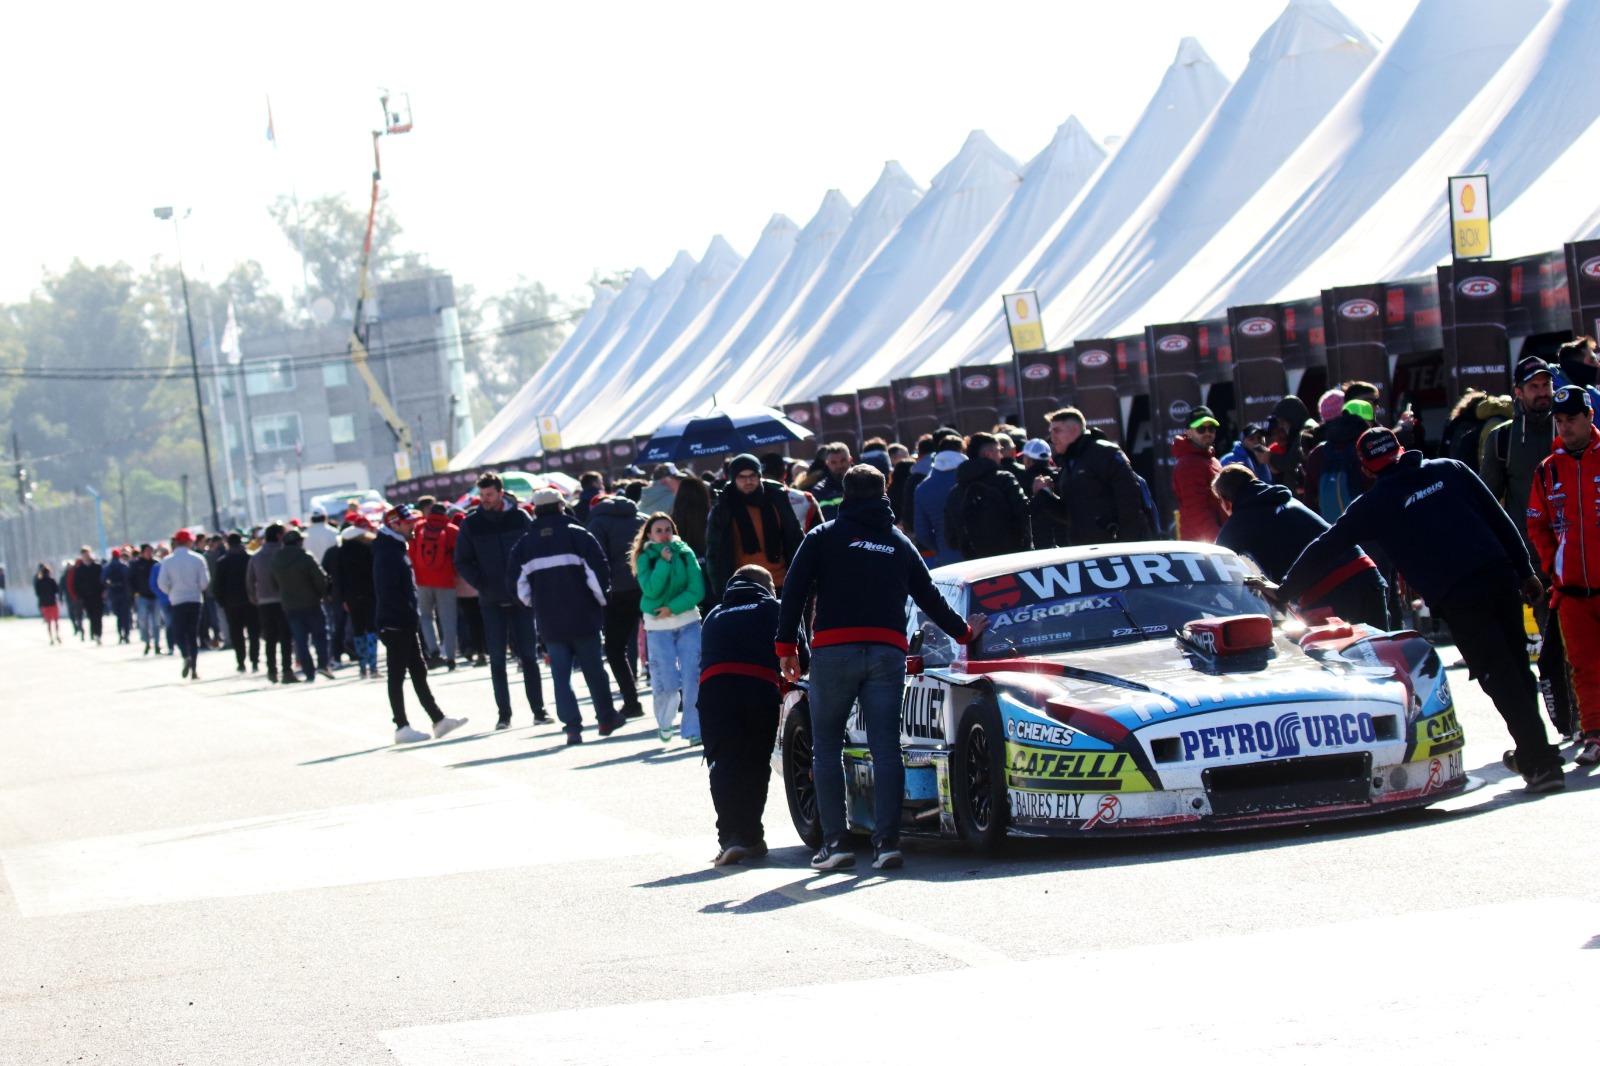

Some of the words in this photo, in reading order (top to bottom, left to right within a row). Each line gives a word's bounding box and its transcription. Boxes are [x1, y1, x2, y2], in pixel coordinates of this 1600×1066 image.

[1459, 227, 1482, 248] BOX
[693, 445, 731, 456] MOTOMEL
[1017, 552, 1252, 600] WÜRTH
[991, 596, 1114, 630] AGROTAX
[1022, 631, 1072, 644] CRISTEM
[1016, 721, 1076, 746] CHEMES
[1301, 712, 1377, 748] URCO
[1012, 750, 1128, 778] CATELLI
[1016, 791, 1053, 818] BAIRES
[1055, 793, 1086, 819] FLY
